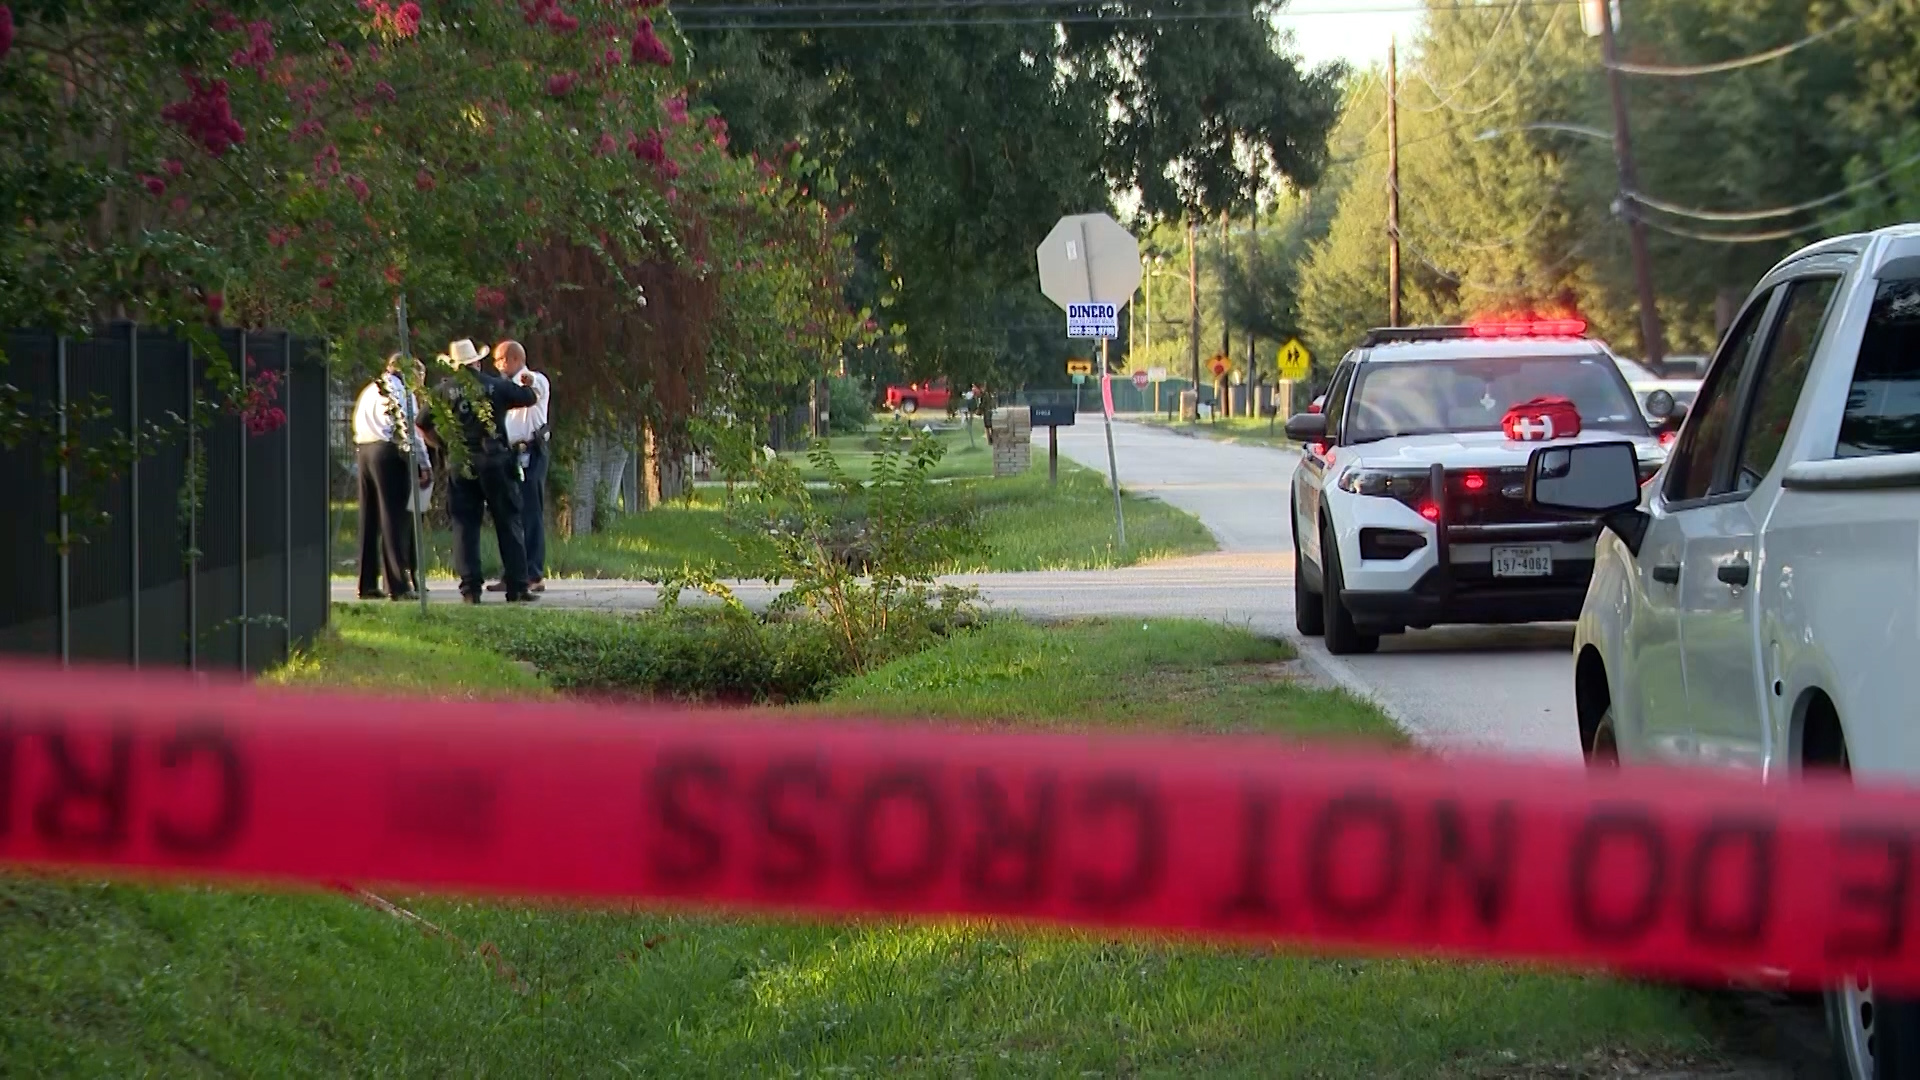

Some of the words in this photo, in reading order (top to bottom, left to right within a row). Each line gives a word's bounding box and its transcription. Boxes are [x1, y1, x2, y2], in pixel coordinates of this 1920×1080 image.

[1069, 305, 1114, 318] DINERO
[646, 736, 1175, 913] CROSS
[1215, 770, 1523, 930] NOT
[1569, 799, 1775, 950] DO
